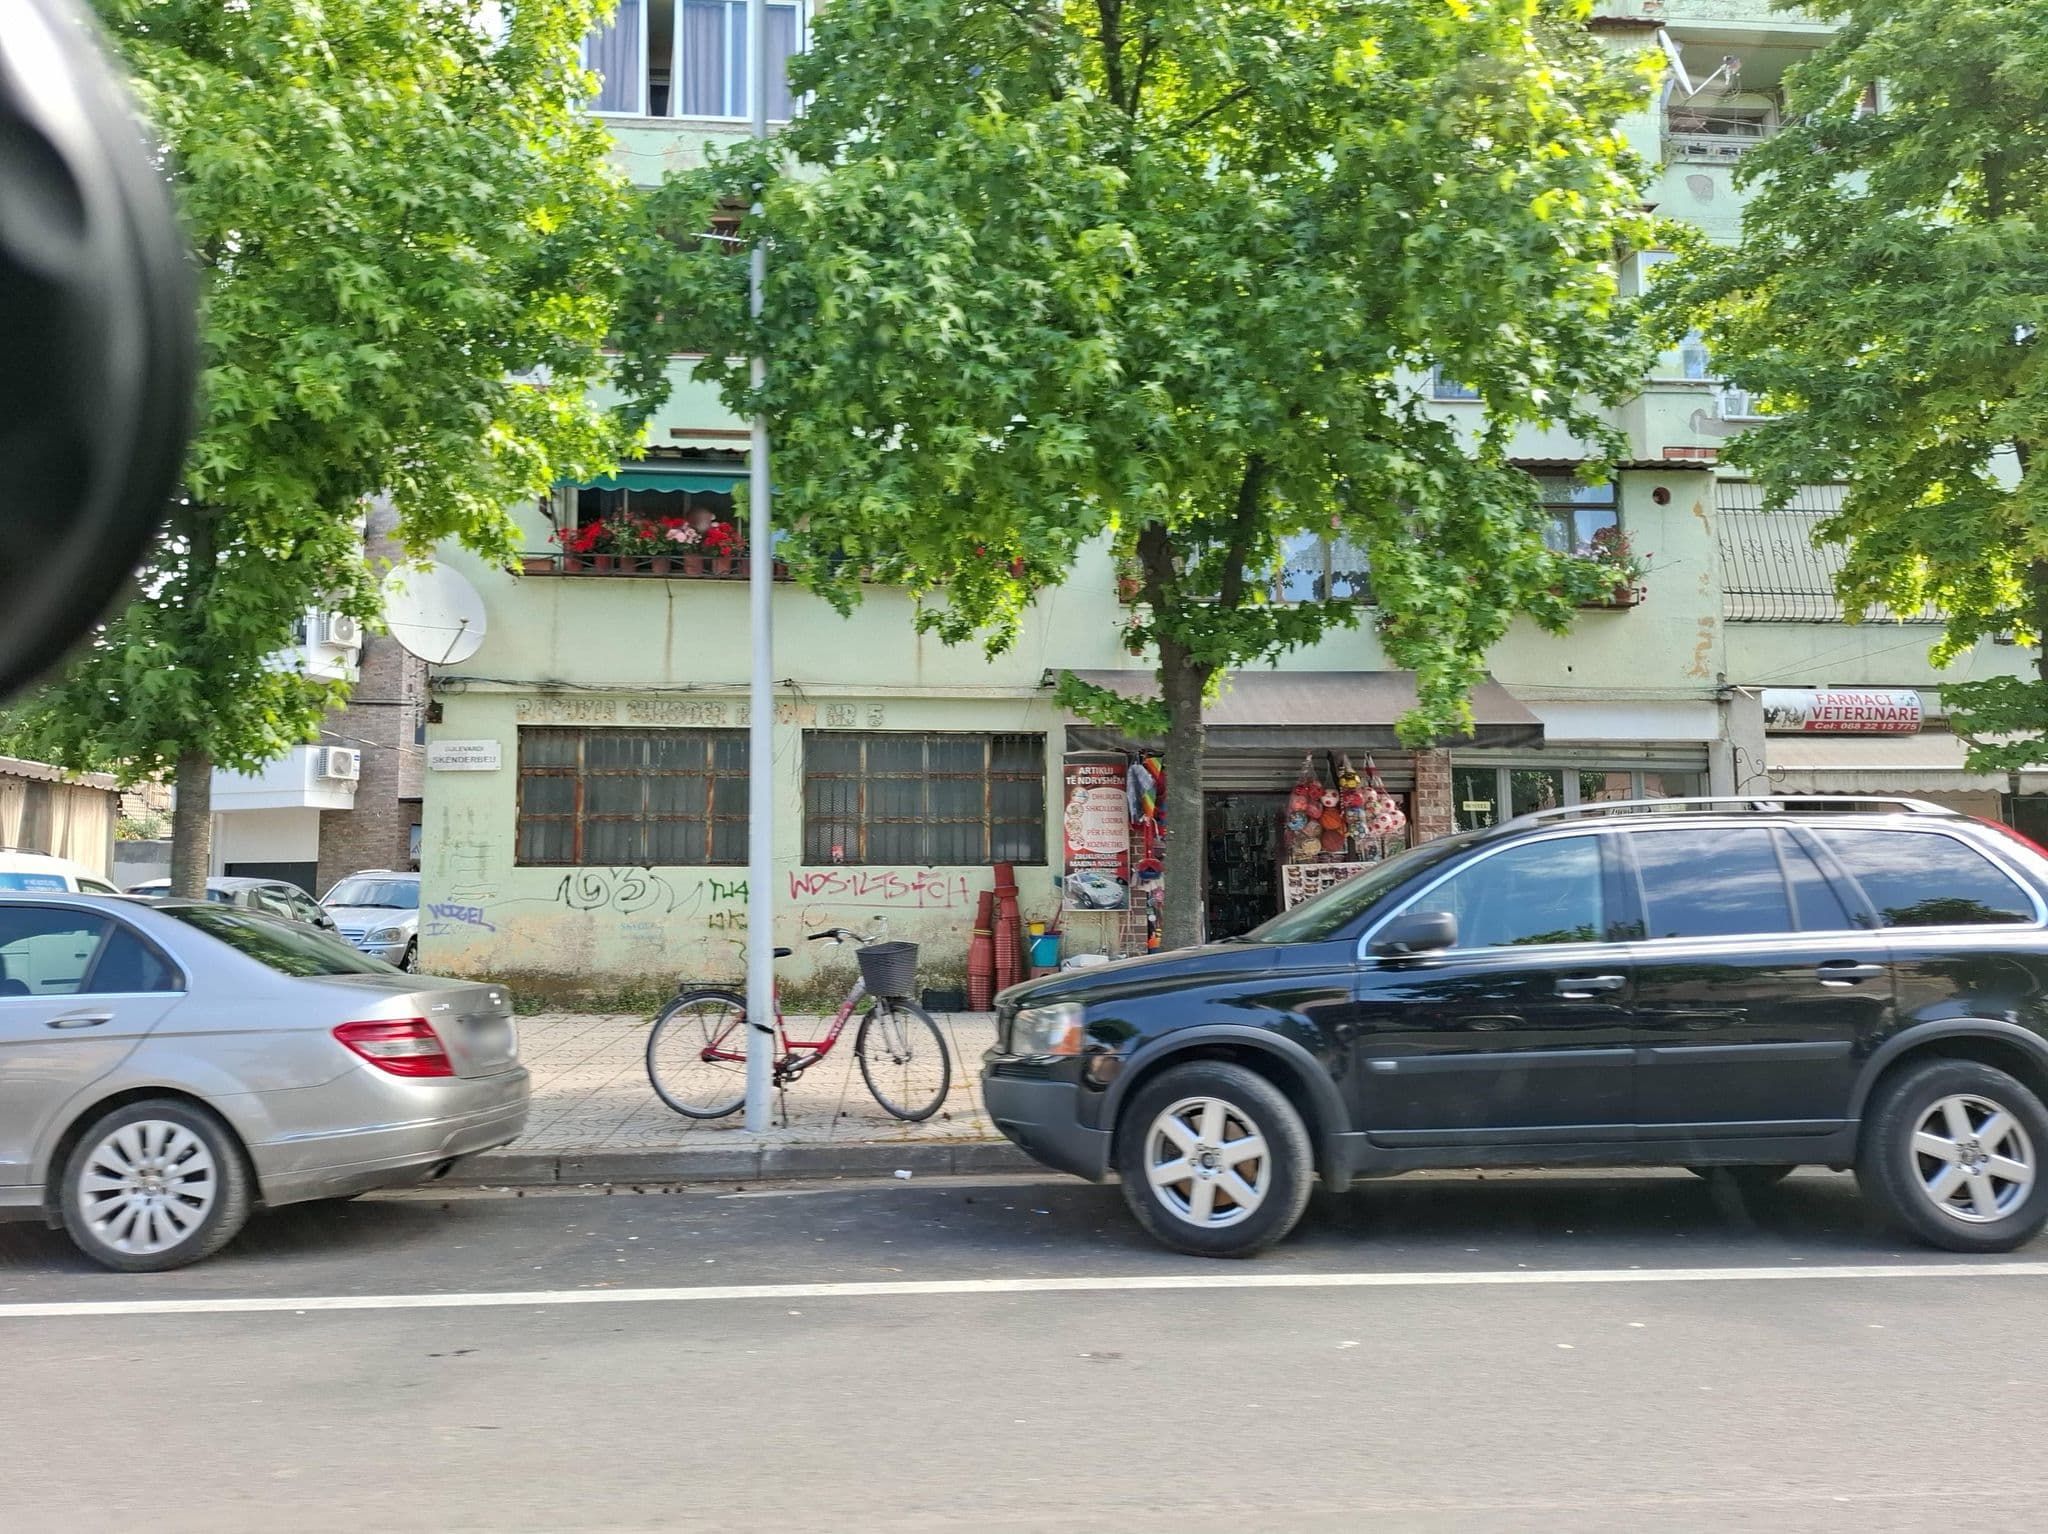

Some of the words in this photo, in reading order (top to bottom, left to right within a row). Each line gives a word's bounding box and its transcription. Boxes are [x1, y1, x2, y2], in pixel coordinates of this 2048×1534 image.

[1816, 694, 1894, 705] FARMACI
[826, 702, 856, 727] NR
[866, 703, 885, 727] 5
[1812, 707, 1919, 721] VETERINARE
[1814, 722, 1838, 730] Cel:
[1840, 722, 1861, 730] 068
[1079, 767, 1113, 775] ARTIKUJ
